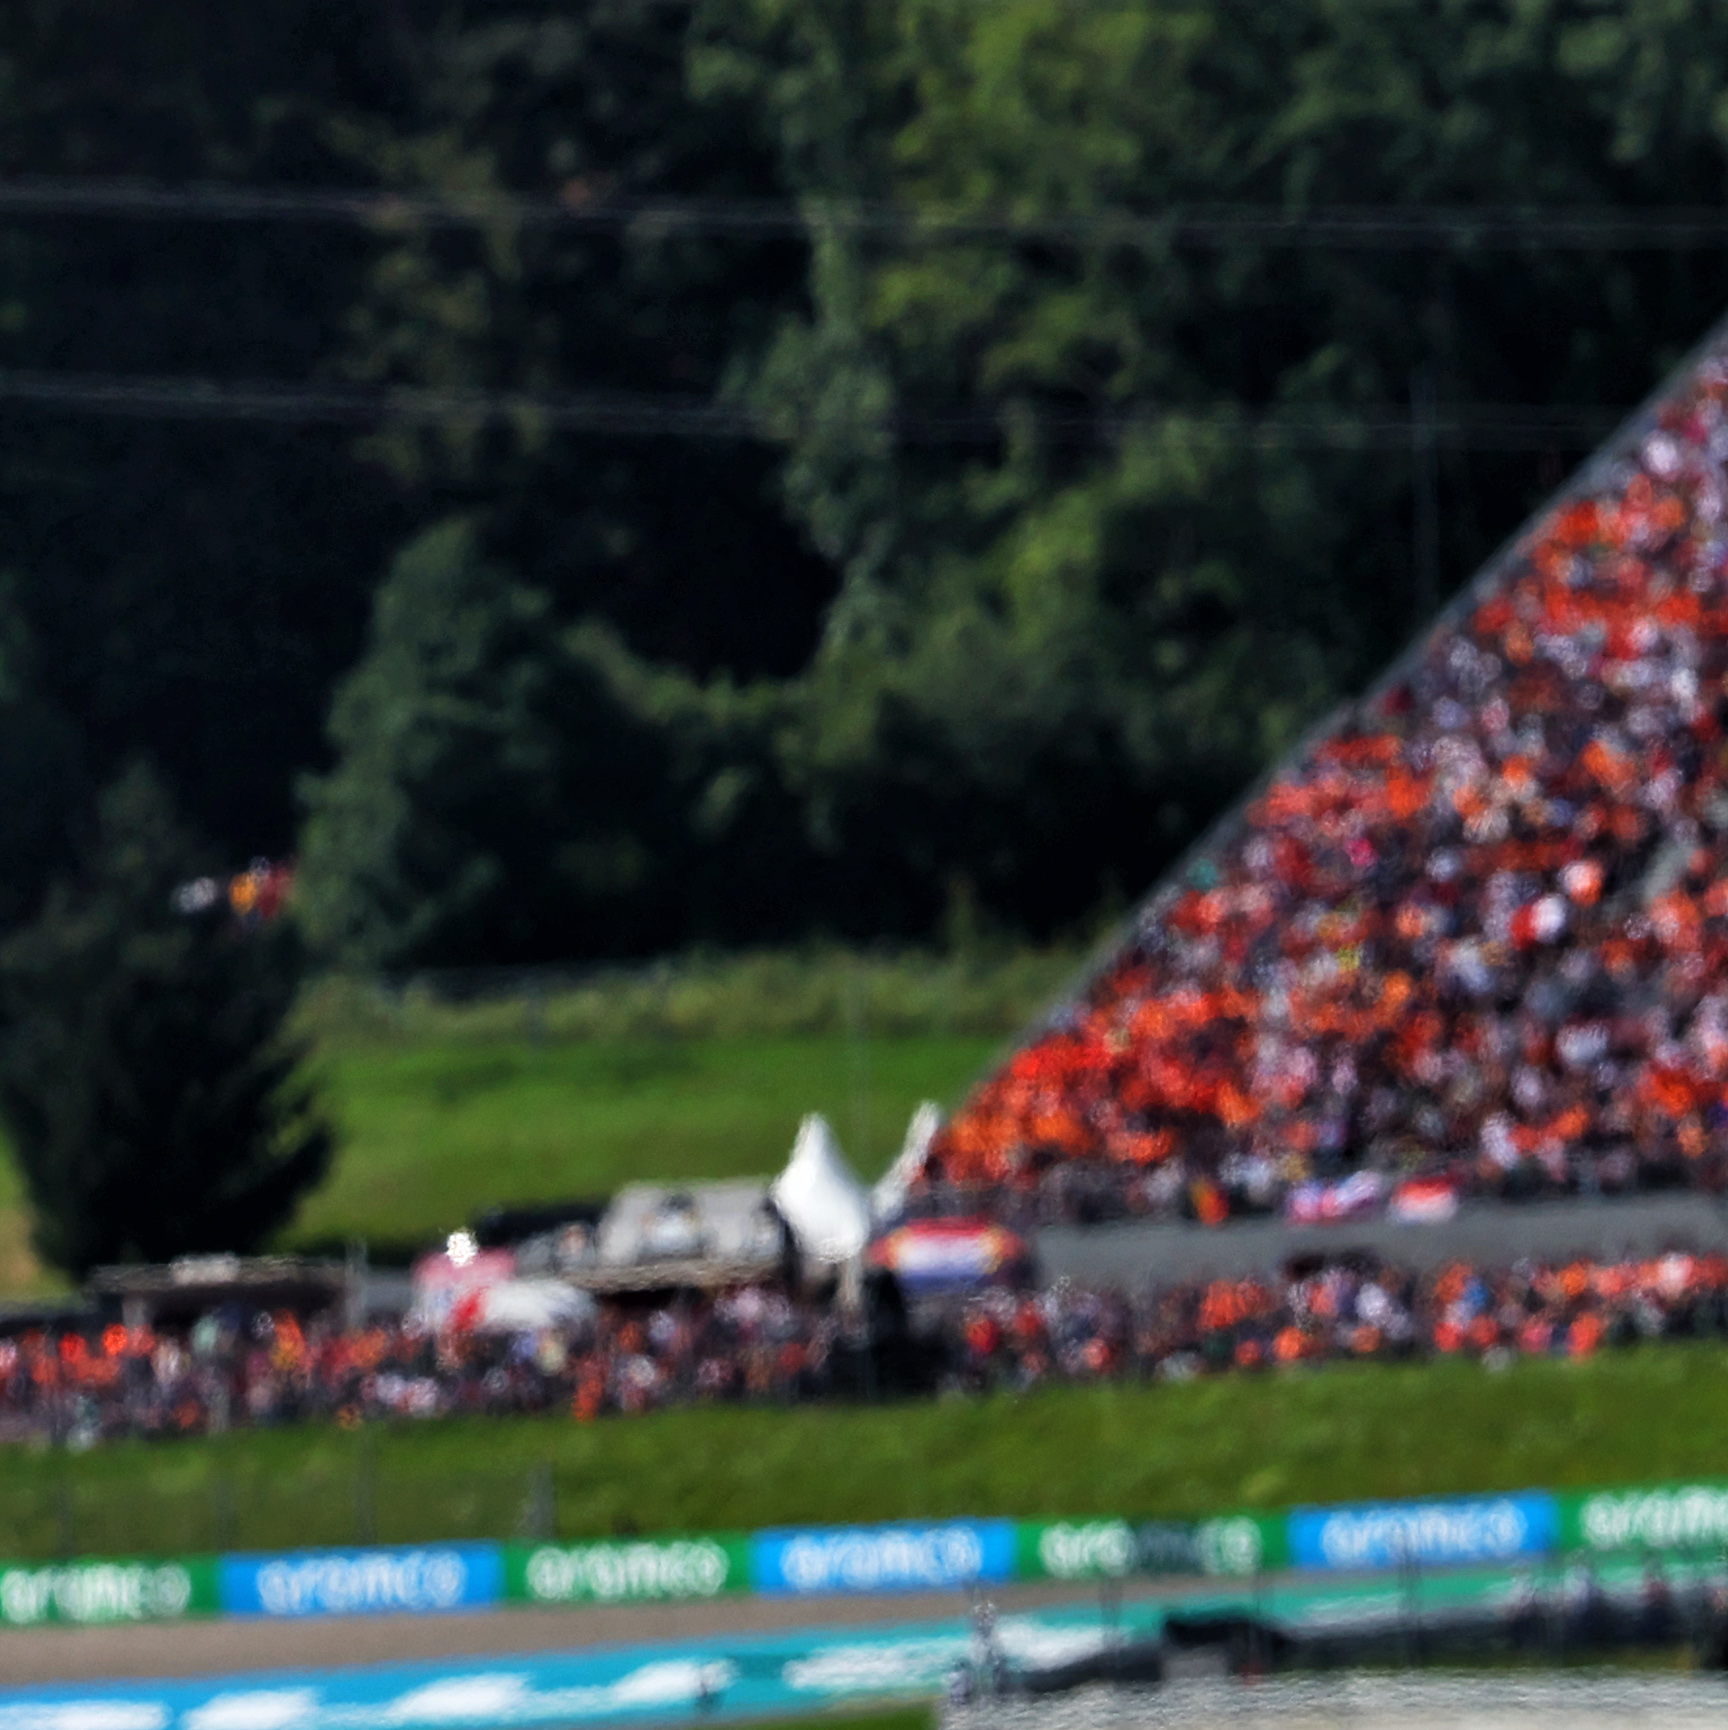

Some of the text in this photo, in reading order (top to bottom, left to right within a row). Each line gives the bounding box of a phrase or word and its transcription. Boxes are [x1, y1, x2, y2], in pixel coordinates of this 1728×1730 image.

[781, 1525, 982, 1590] aramco
[1039, 1516, 1262, 1579] araco
[1320, 1508, 1527, 1568] aramco
[257, 1550, 468, 1614] aramco
[527, 1539, 729, 1601] aramco
